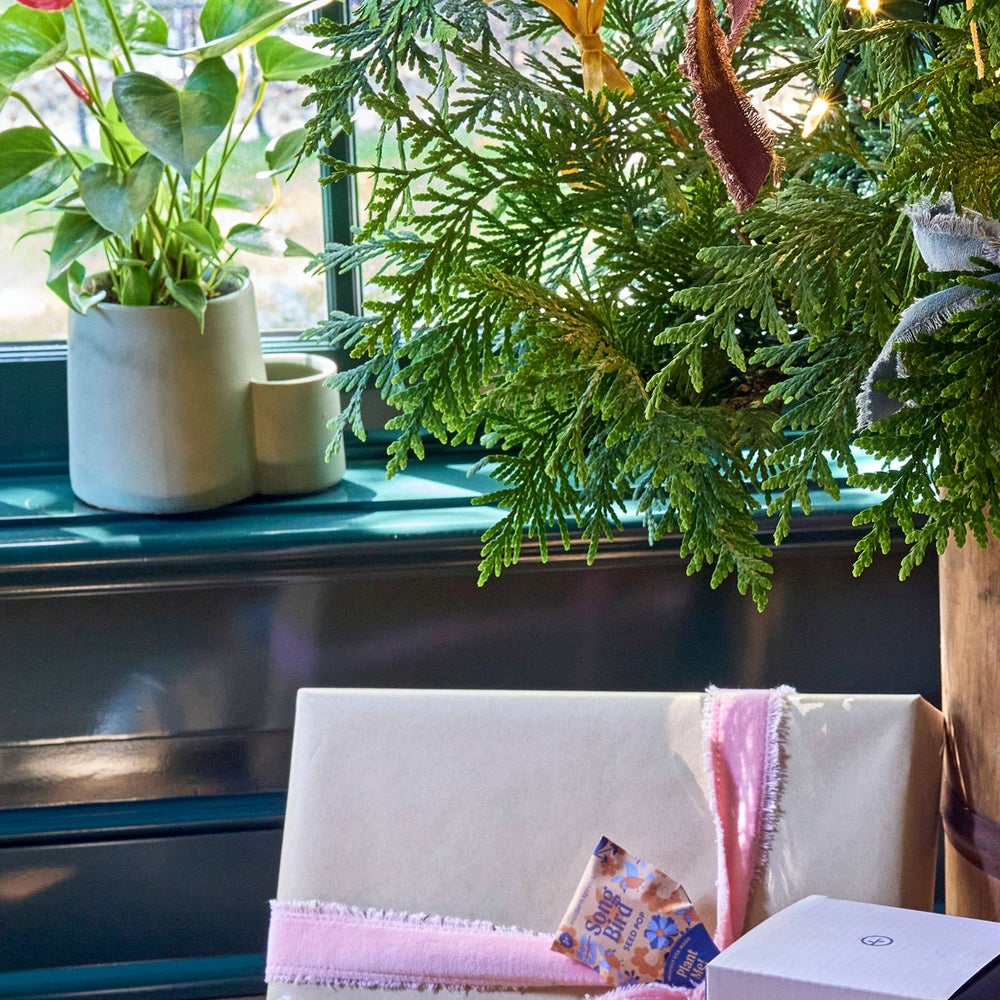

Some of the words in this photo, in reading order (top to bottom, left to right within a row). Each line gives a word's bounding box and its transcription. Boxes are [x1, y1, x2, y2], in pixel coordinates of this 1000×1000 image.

[585, 886, 621, 936] Song
[603, 903, 633, 943] Bird
[623, 930, 638, 951] SEED
[634, 912, 645, 930] POP
[676, 949, 698, 978] Plant
[690, 957, 707, 980] Me!
